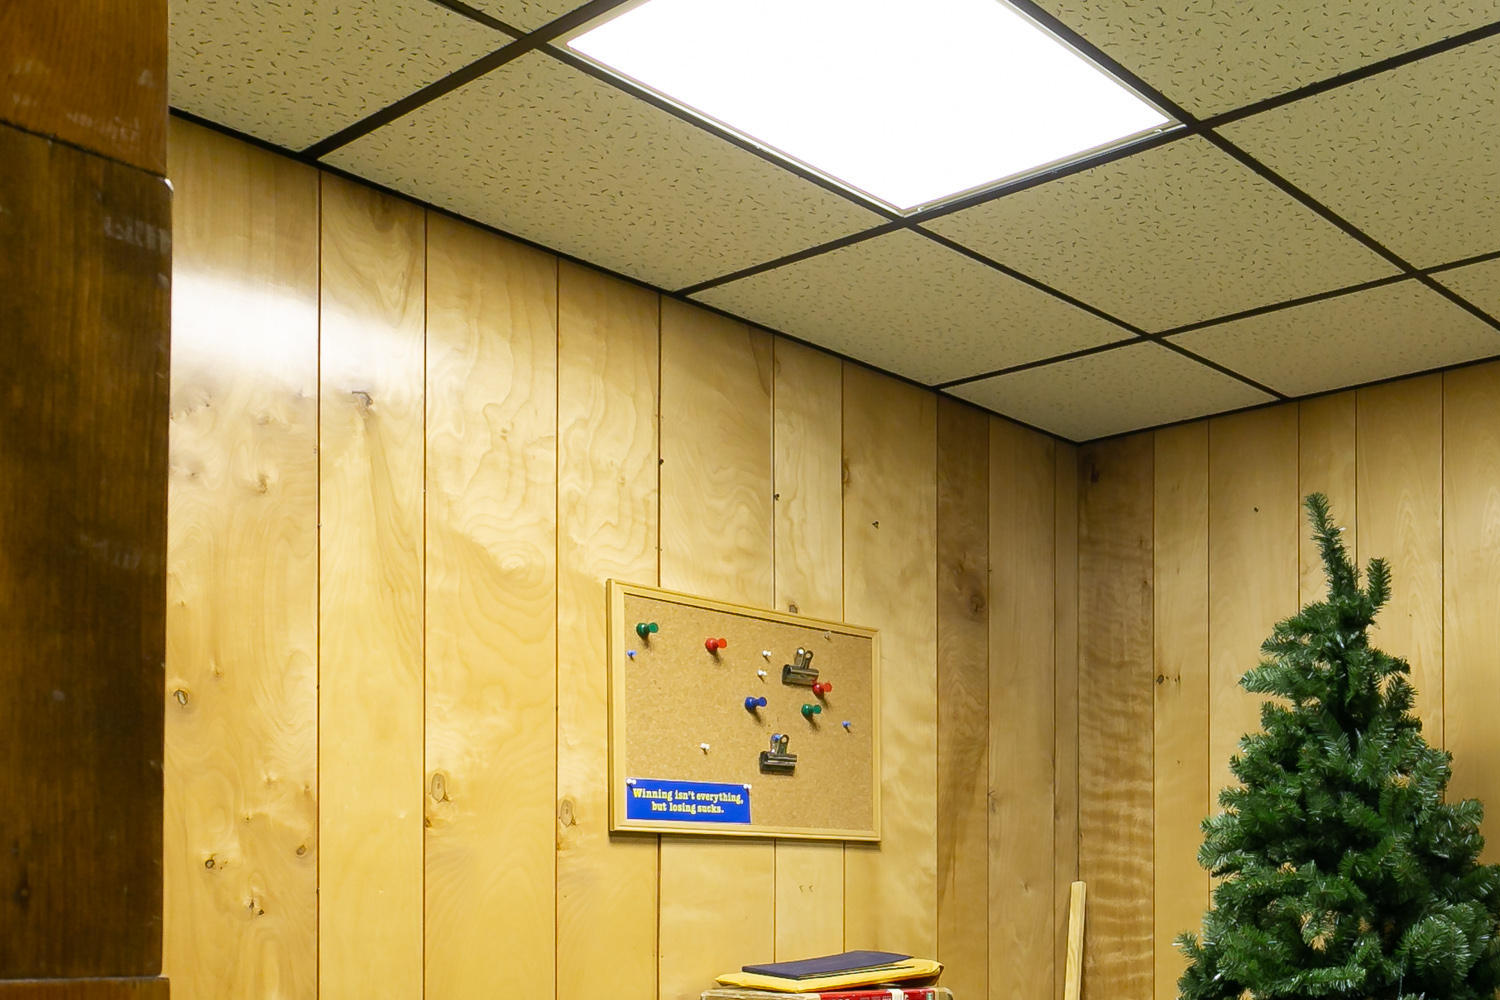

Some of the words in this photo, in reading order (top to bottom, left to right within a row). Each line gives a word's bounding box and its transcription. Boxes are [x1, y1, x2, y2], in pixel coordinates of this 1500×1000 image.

[632, 788, 672, 802] Winning
[674, 790, 695, 800] isn't
[696, 792, 744, 805] everything,
[651, 801, 667, 811] but
[669, 802, 696, 815] losing
[697, 804, 725, 814] sucks.
